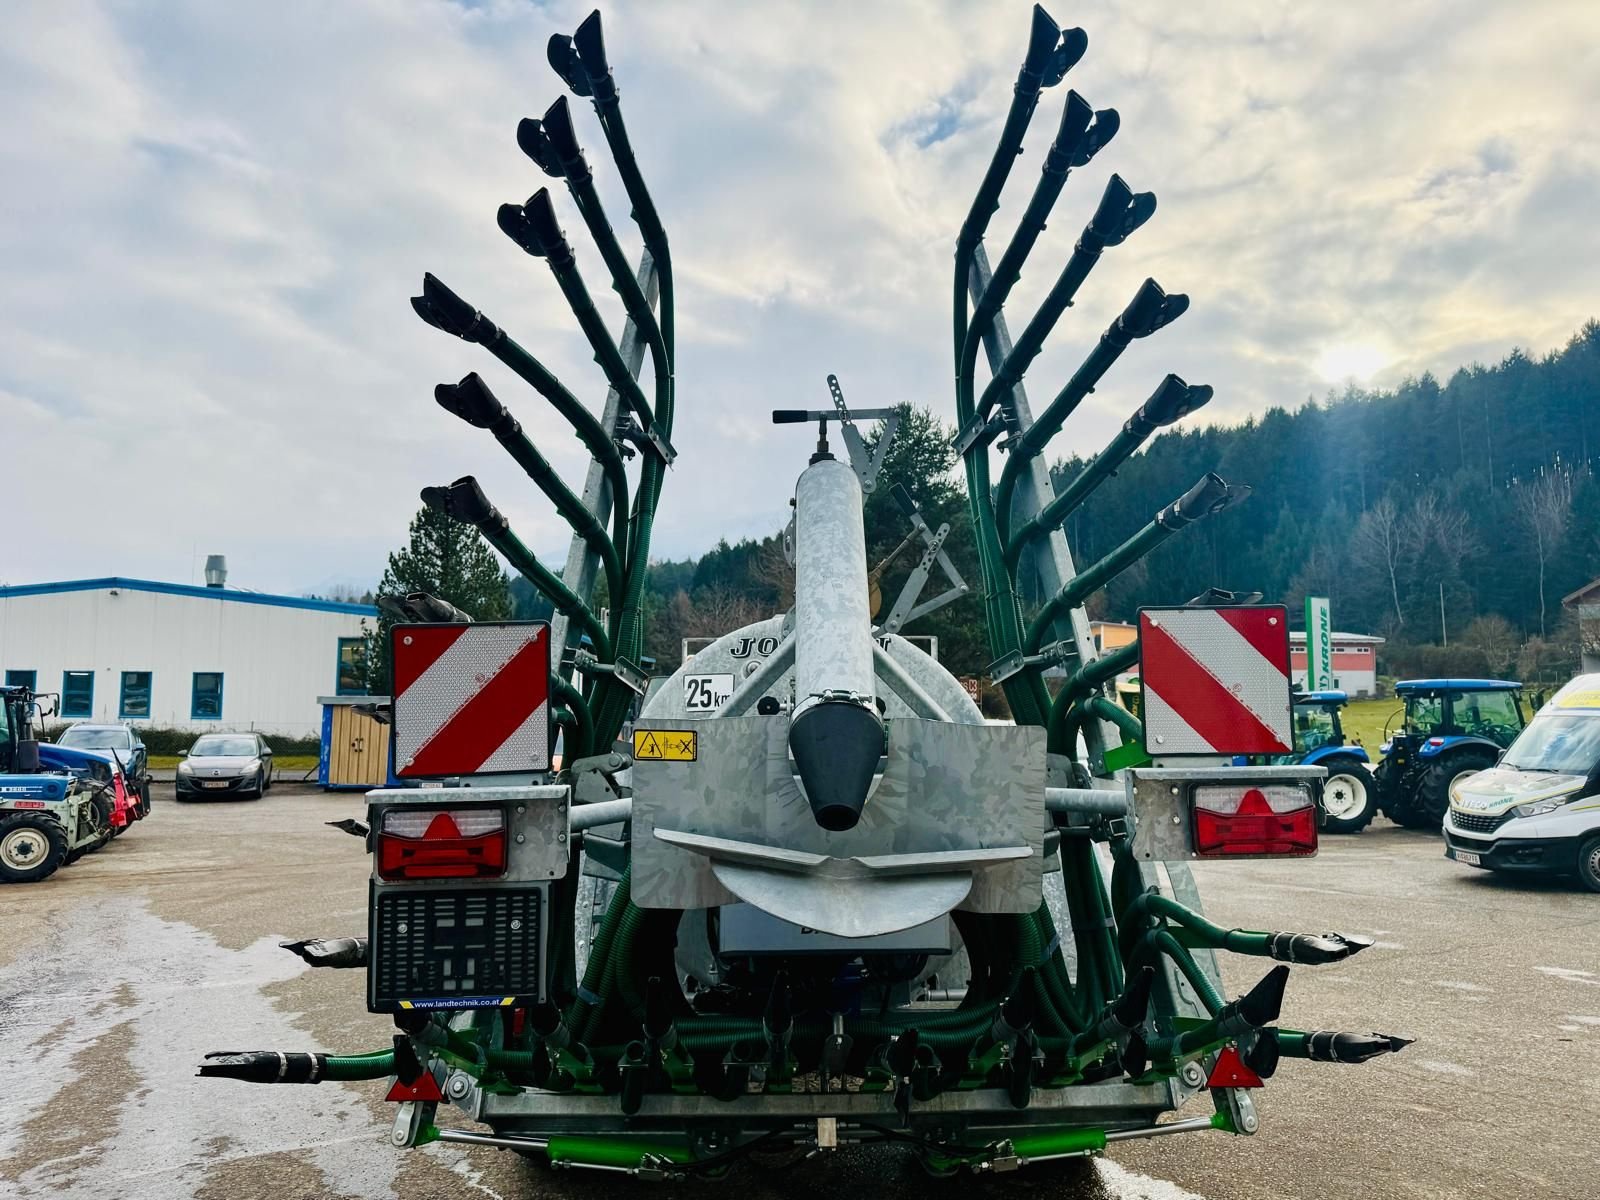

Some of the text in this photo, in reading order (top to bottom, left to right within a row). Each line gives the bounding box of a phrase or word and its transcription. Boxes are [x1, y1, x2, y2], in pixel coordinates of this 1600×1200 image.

[1320, 606, 1329, 674] KRONE
[686, 678, 713, 708] 25
[414, 999, 500, 1008] www.landtechnik.co.at
